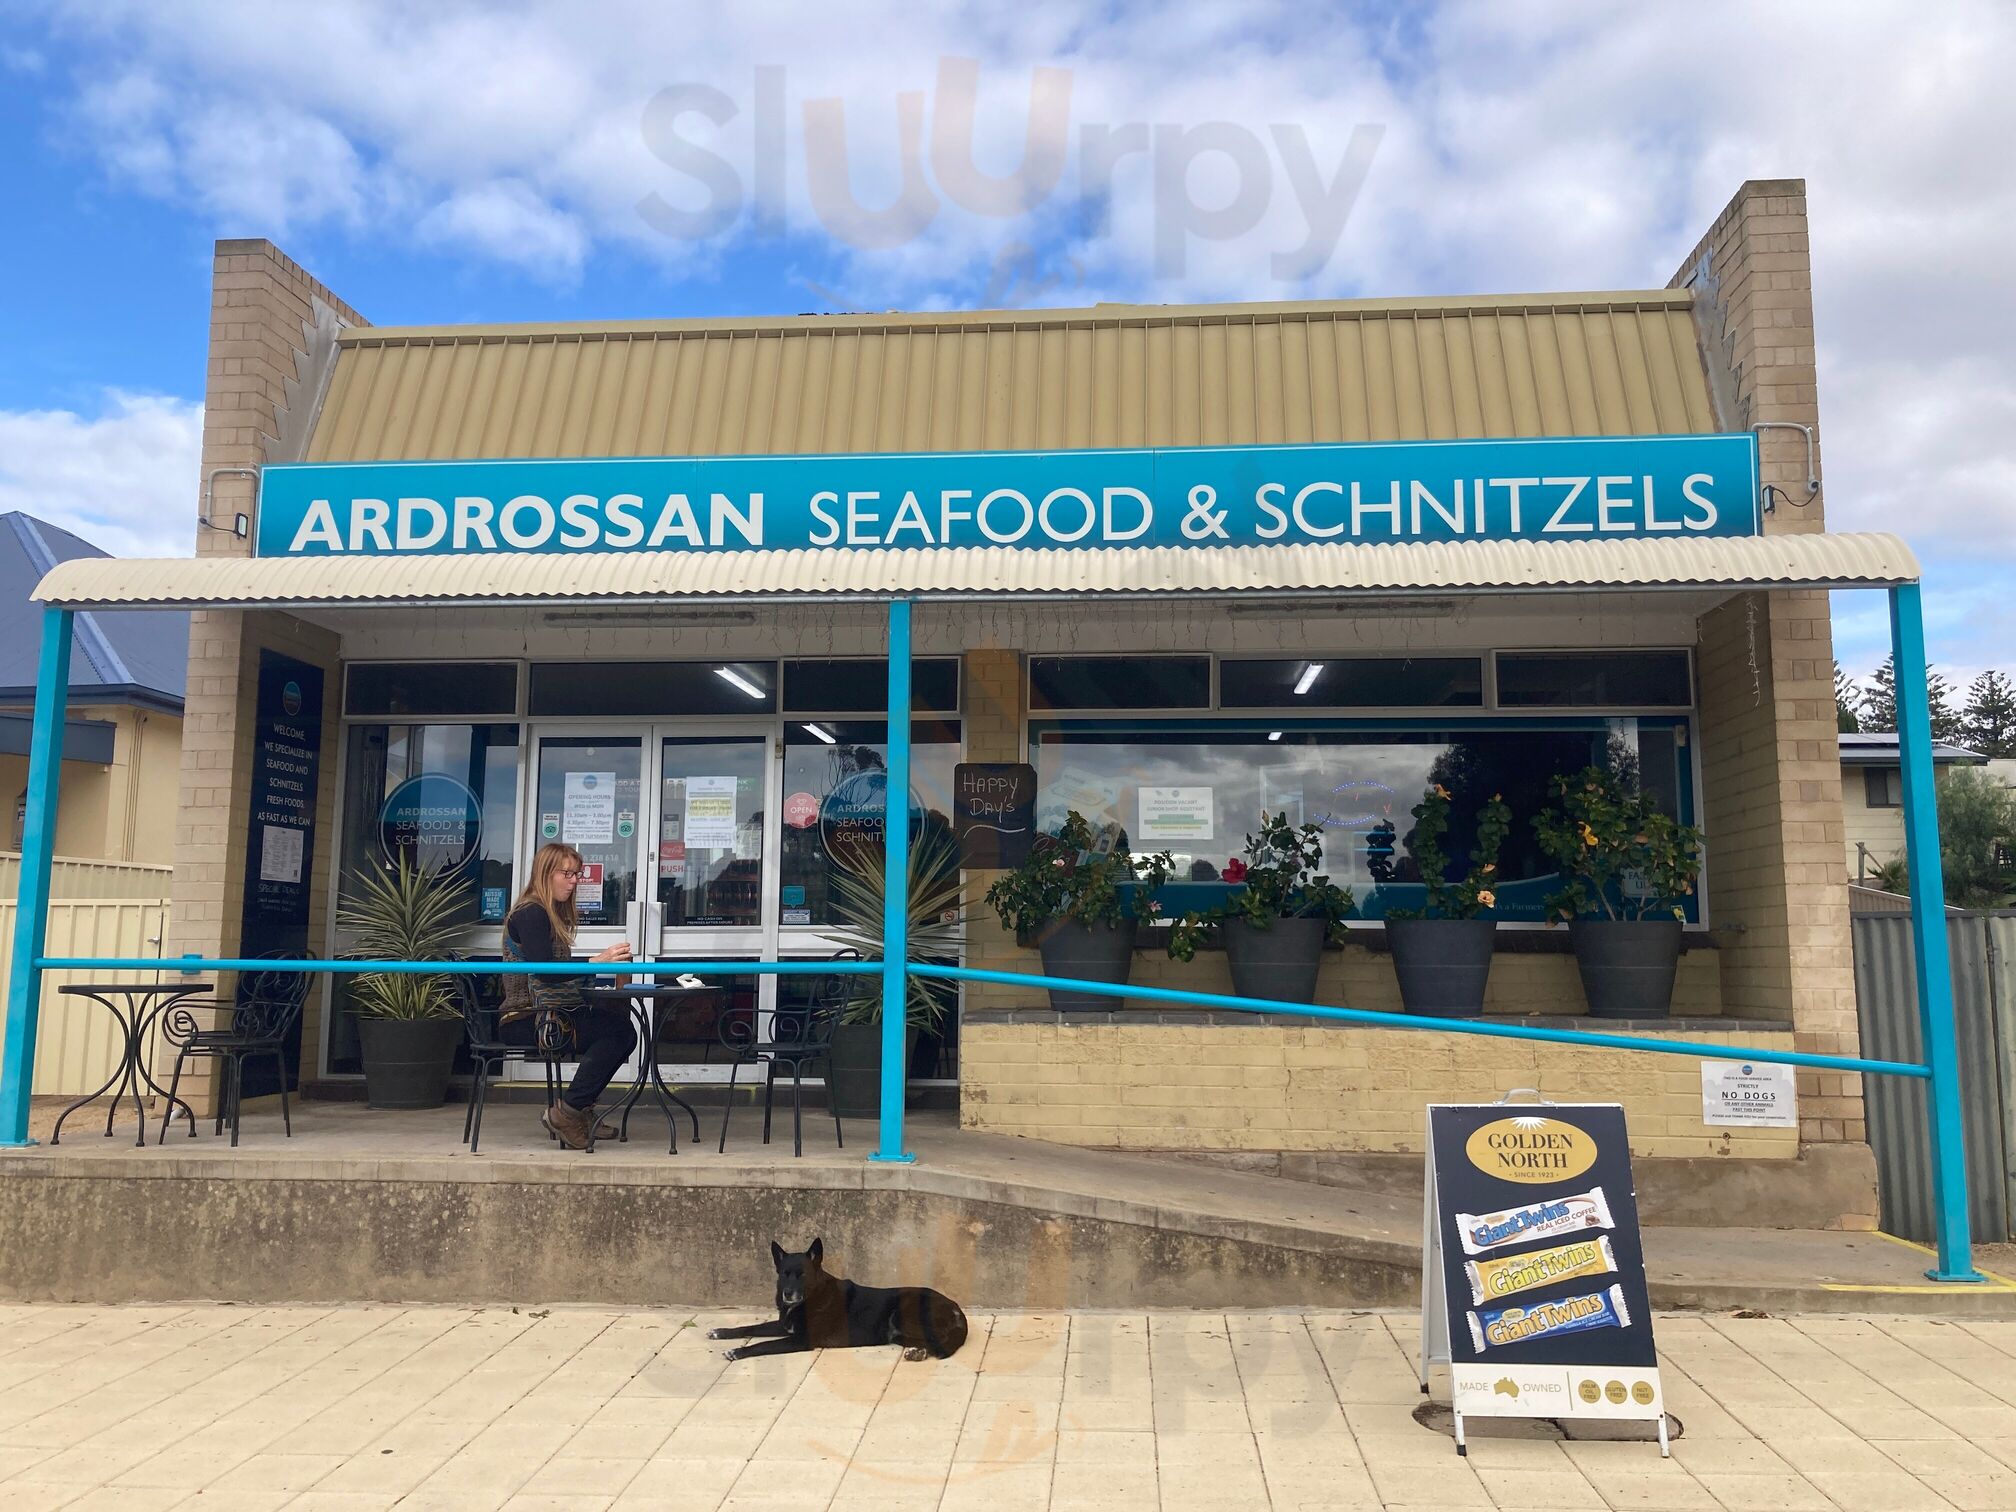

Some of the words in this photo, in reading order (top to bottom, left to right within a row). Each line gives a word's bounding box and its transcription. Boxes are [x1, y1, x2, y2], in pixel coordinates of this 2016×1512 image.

[288, 493, 765, 551] ARDROSSAN
[808, 487, 1154, 547] SEAFOOD
[1179, 484, 1229, 540] &
[1254, 473, 1718, 539] SCHNITZELS
[264, 741, 274, 751] WE
[275, 744, 305, 758] SPECIALIZE
[305, 751, 313, 760] IN
[266, 758, 295, 772] SEAFOOD
[295, 765, 309, 775] AND
[963, 769, 1019, 799] HAPPY
[267, 795, 284, 805] FRESH
[396, 807, 466, 816] ARDROSSAN
[790, 806, 813, 814] OPEN
[837, 804, 887, 813] ARDROS
[257, 812, 266, 821] AS
[266, 813, 279, 822] FAST
[280, 815, 288, 823] AS
[289, 816, 298, 824] WE
[298, 817, 311, 826] CAN
[836, 817, 887, 828] SEAFOO
[396, 820, 452, 831] SEAFOOD
[458, 821, 466, 831] &
[395, 834, 465, 845] SCHNITZELS
[836, 831, 887, 842] SCHNIT
[1721, 1091, 1738, 1099] NO
[1744, 1092, 1776, 1100] DOGS
[1488, 1133, 1573, 1149] GOLDEN
[1498, 1152, 1568, 1168] NORTH
[1536, 1222, 1554, 1232] REAL
[1555, 1216, 1570, 1227] ICED
[1571, 1206, 1597, 1219] COFFEE
[1459, 1382, 1489, 1391] MADE
[1522, 1383, 1562, 1393] OWNED
